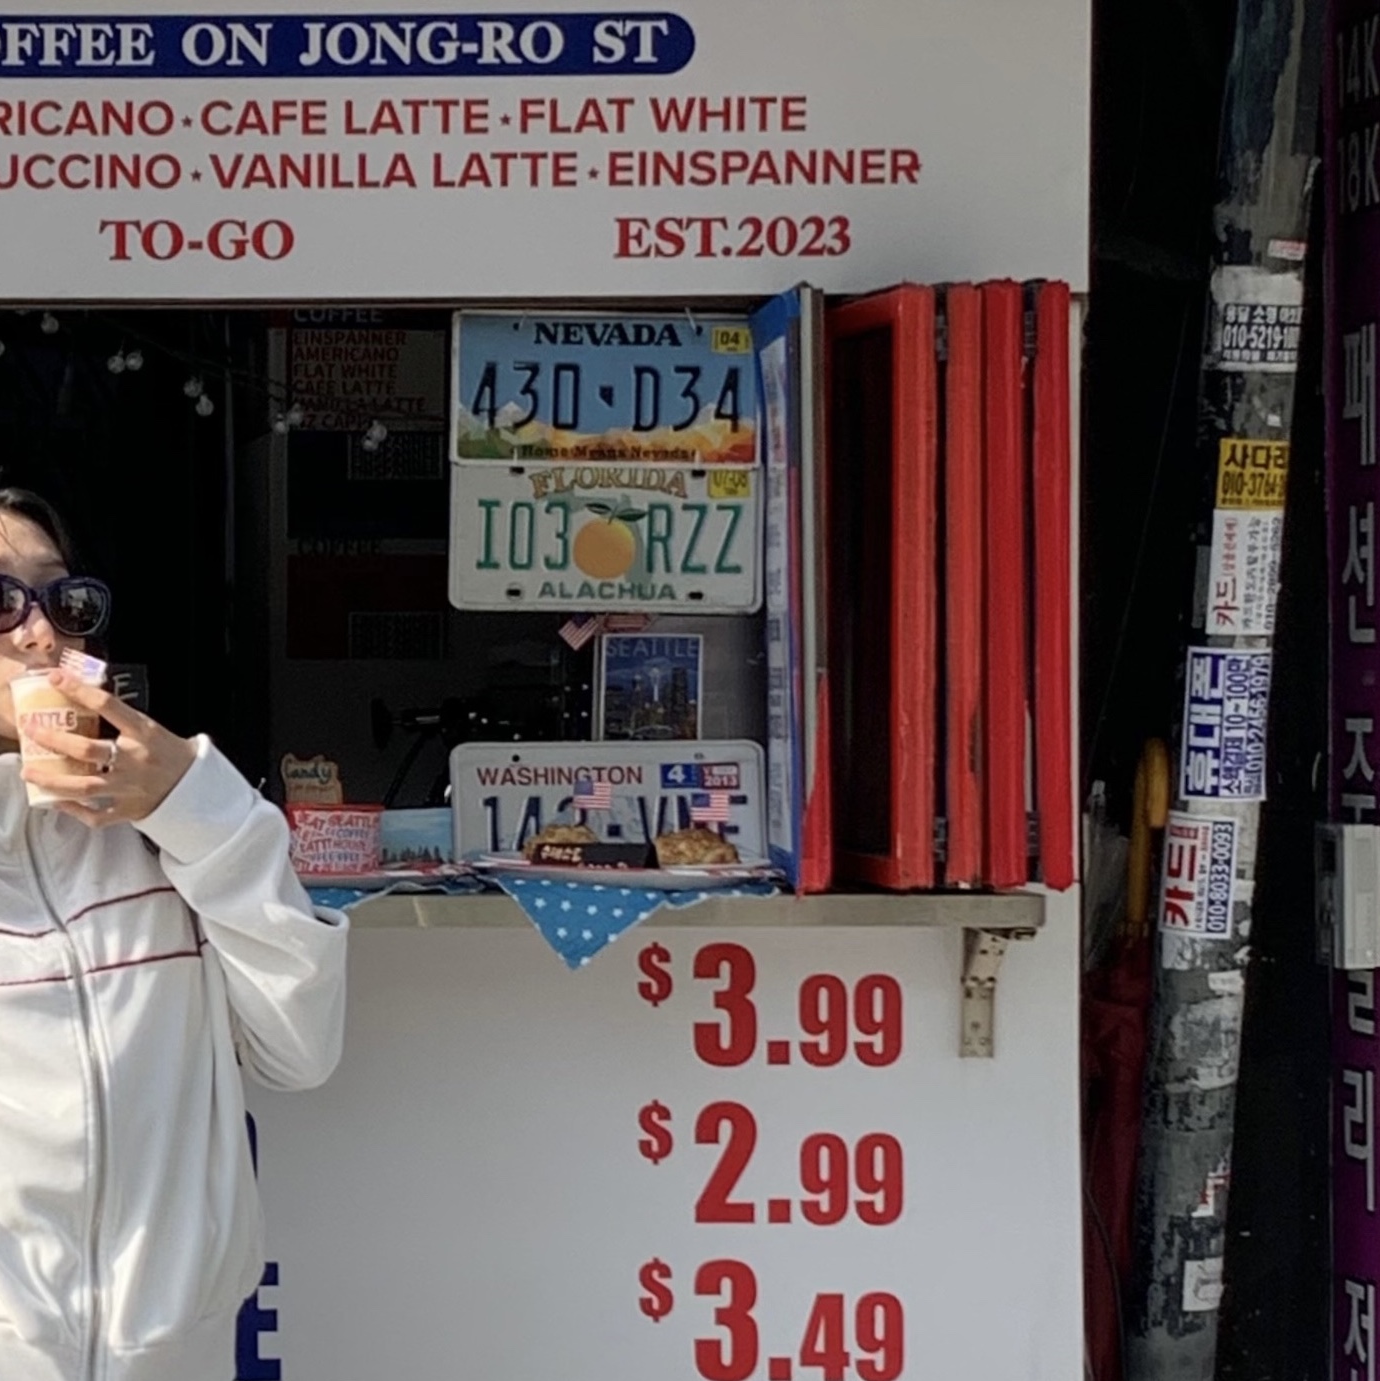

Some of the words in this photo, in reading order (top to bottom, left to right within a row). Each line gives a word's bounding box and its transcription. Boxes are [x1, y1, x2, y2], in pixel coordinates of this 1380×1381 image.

[182, 23, 273, 66] ON
[299, 22, 564, 66] JONG-RO
[593, 20, 669, 63] ST
[200, 99, 327, 136] CAFE
[343, 98, 490, 135] LATTE
[519, 98, 633, 133] FLAT
[650, 96, 808, 132] WHITE
[210, 152, 417, 189] VANILLA
[432, 152, 579, 187] LATTE
[607, 149, 921, 186] EINSPANNER
[100, 219, 295, 261] TO-GO
[614, 216, 852, 259] EST.2023
[293, 329, 407, 345] EINSPANNER
[534, 322, 683, 347] NEVADA
[720, 331, 740, 345] 04
[293, 346, 399, 361] AMERICANO
[341, 362, 398, 379] WHITE
[341, 380, 397, 397] LATTE
[529, 467, 688, 499] FLORIDA
[646, 503, 742, 574] RZZ
[539, 581, 677, 600] ALACHUA
[605, 638, 699, 657] SEATTLE
[476, 766, 643, 786] WASHINGTON
[1162, 843, 1196, 927] 카드
[638, 942, 904, 1068] $3.99
[638, 1100, 905, 1227] $2.99
